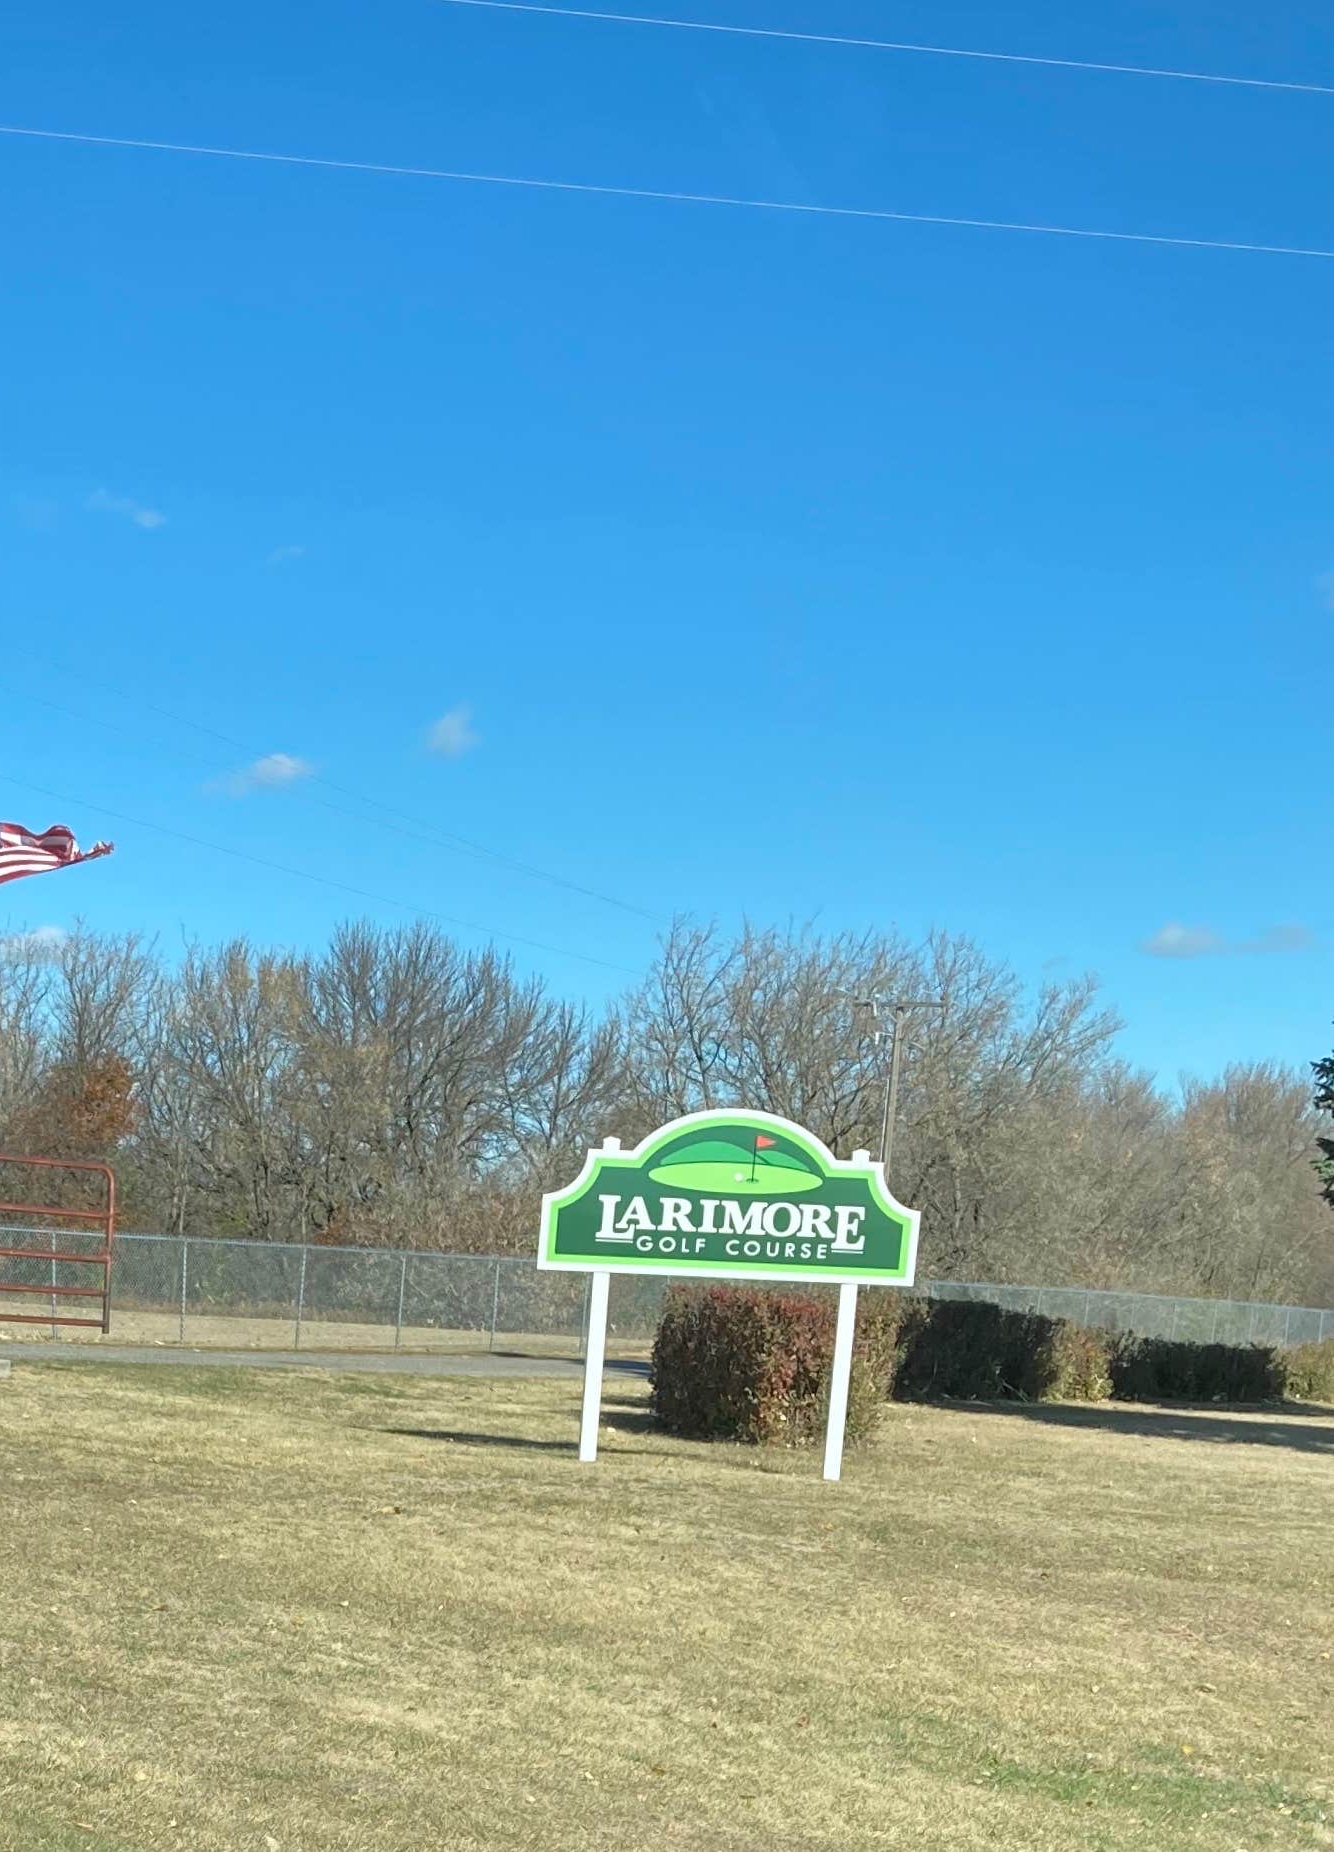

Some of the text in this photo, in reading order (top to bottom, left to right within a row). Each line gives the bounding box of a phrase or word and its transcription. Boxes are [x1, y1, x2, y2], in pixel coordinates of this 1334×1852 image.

[597, 1194, 866, 1251] LARIMORE
[636, 1235, 828, 1259] GOLF COURSE
